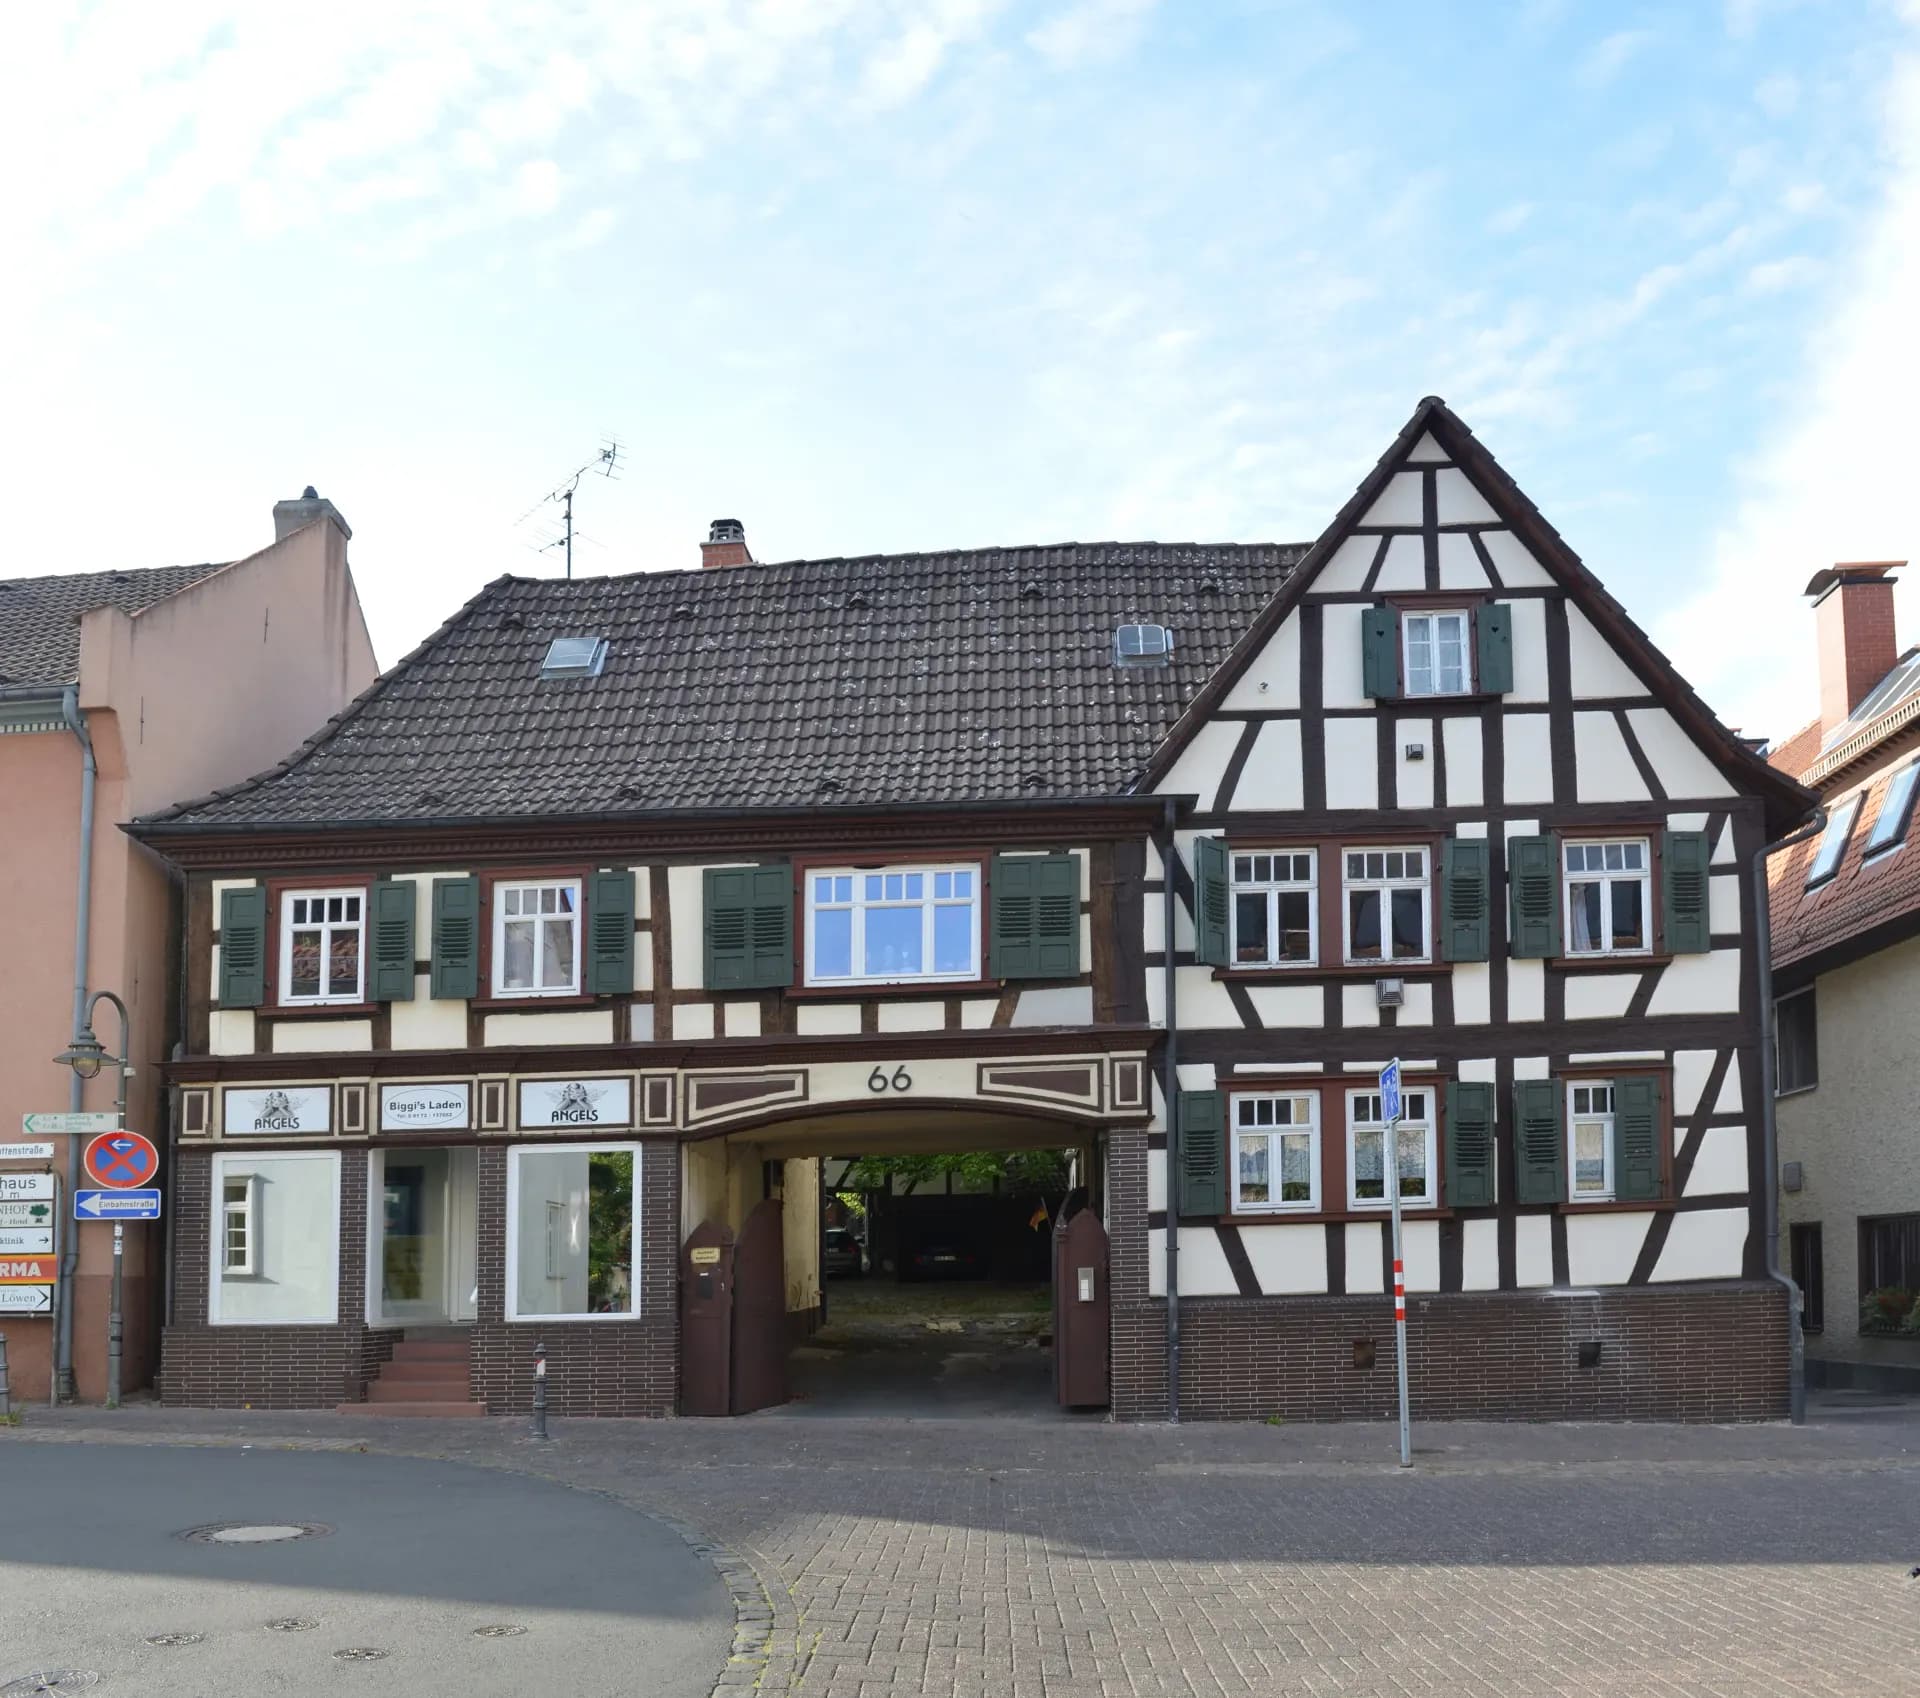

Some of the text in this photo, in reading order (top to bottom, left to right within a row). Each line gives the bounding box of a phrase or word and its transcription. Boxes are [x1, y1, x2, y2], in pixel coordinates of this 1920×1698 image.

[868, 1065, 912, 1092] 66
[389, 1101, 462, 1112] Biggi's Laden
[552, 1109, 598, 1122] ANGELS
[254, 1117, 300, 1130] ANGELS
[0, 1177, 37, 1189] haus
[99, 1200, 154, 1208] Einbahnstraße
[0, 1261, 42, 1277] RMA
